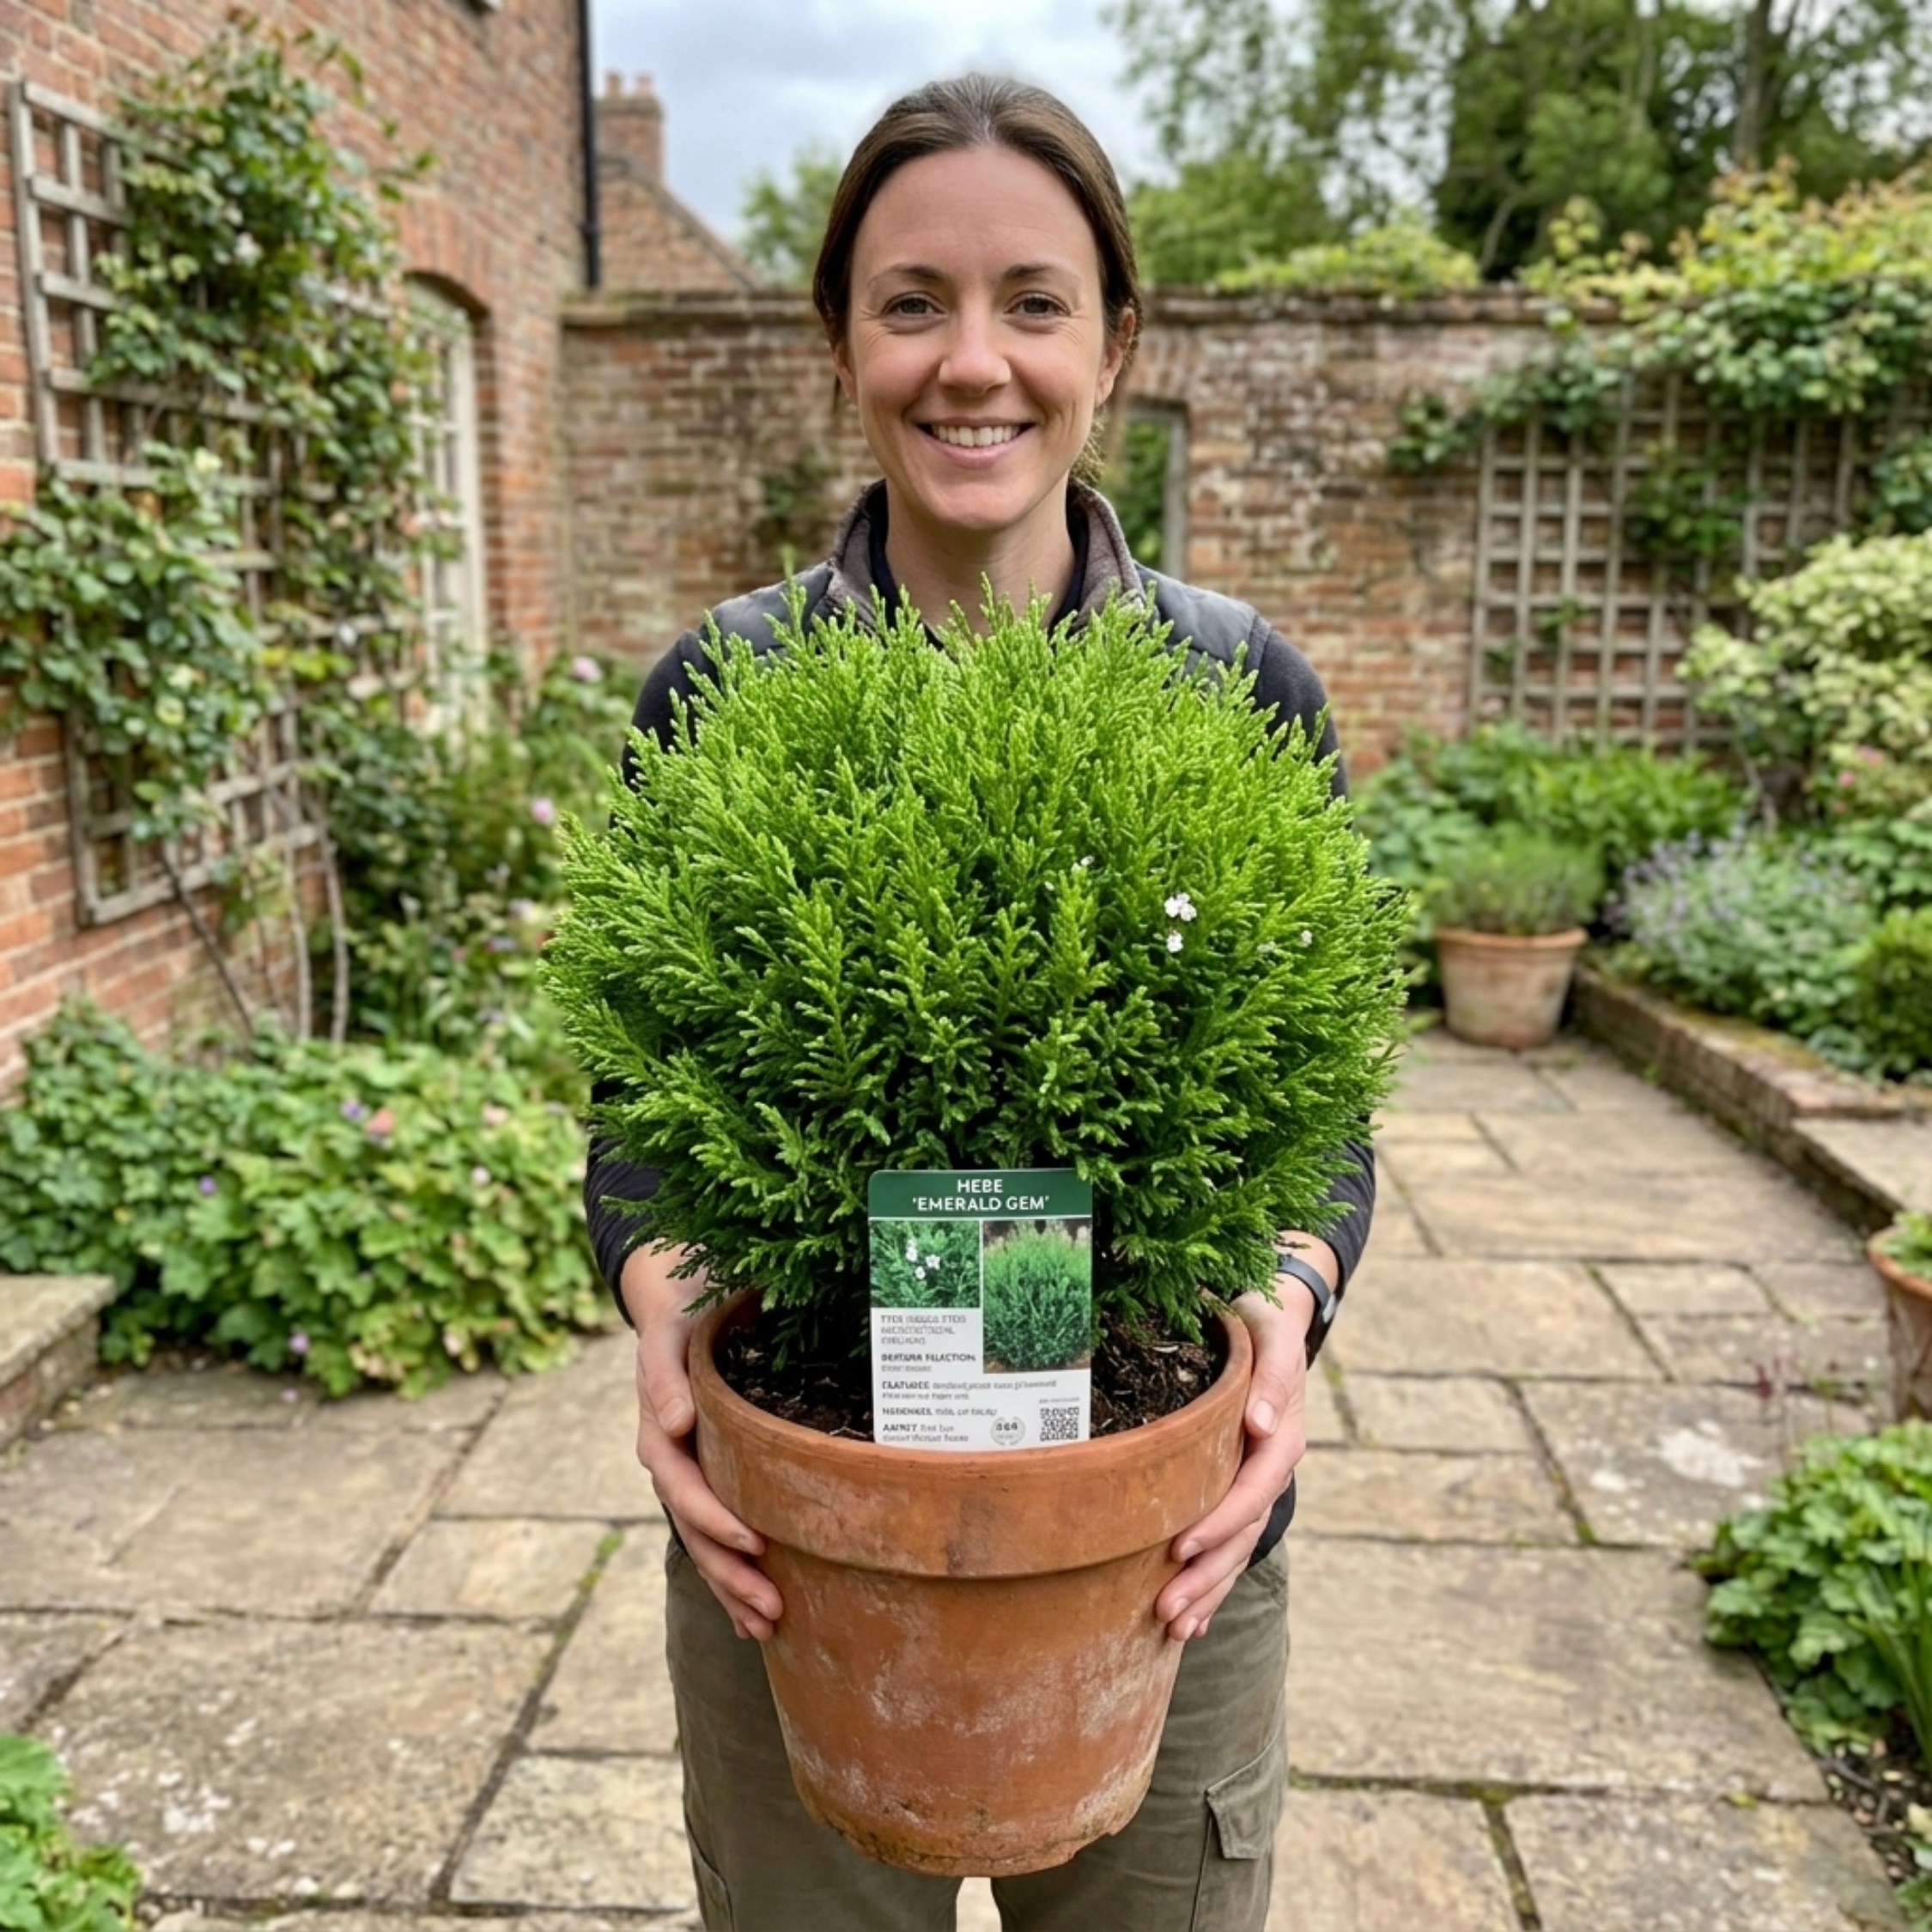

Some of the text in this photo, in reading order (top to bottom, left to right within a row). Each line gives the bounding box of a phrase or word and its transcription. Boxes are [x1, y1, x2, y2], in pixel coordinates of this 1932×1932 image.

[957, 1179, 1003, 1193] HEBE
[913, 1195, 1049, 1212] 'EMERALD GEM'
